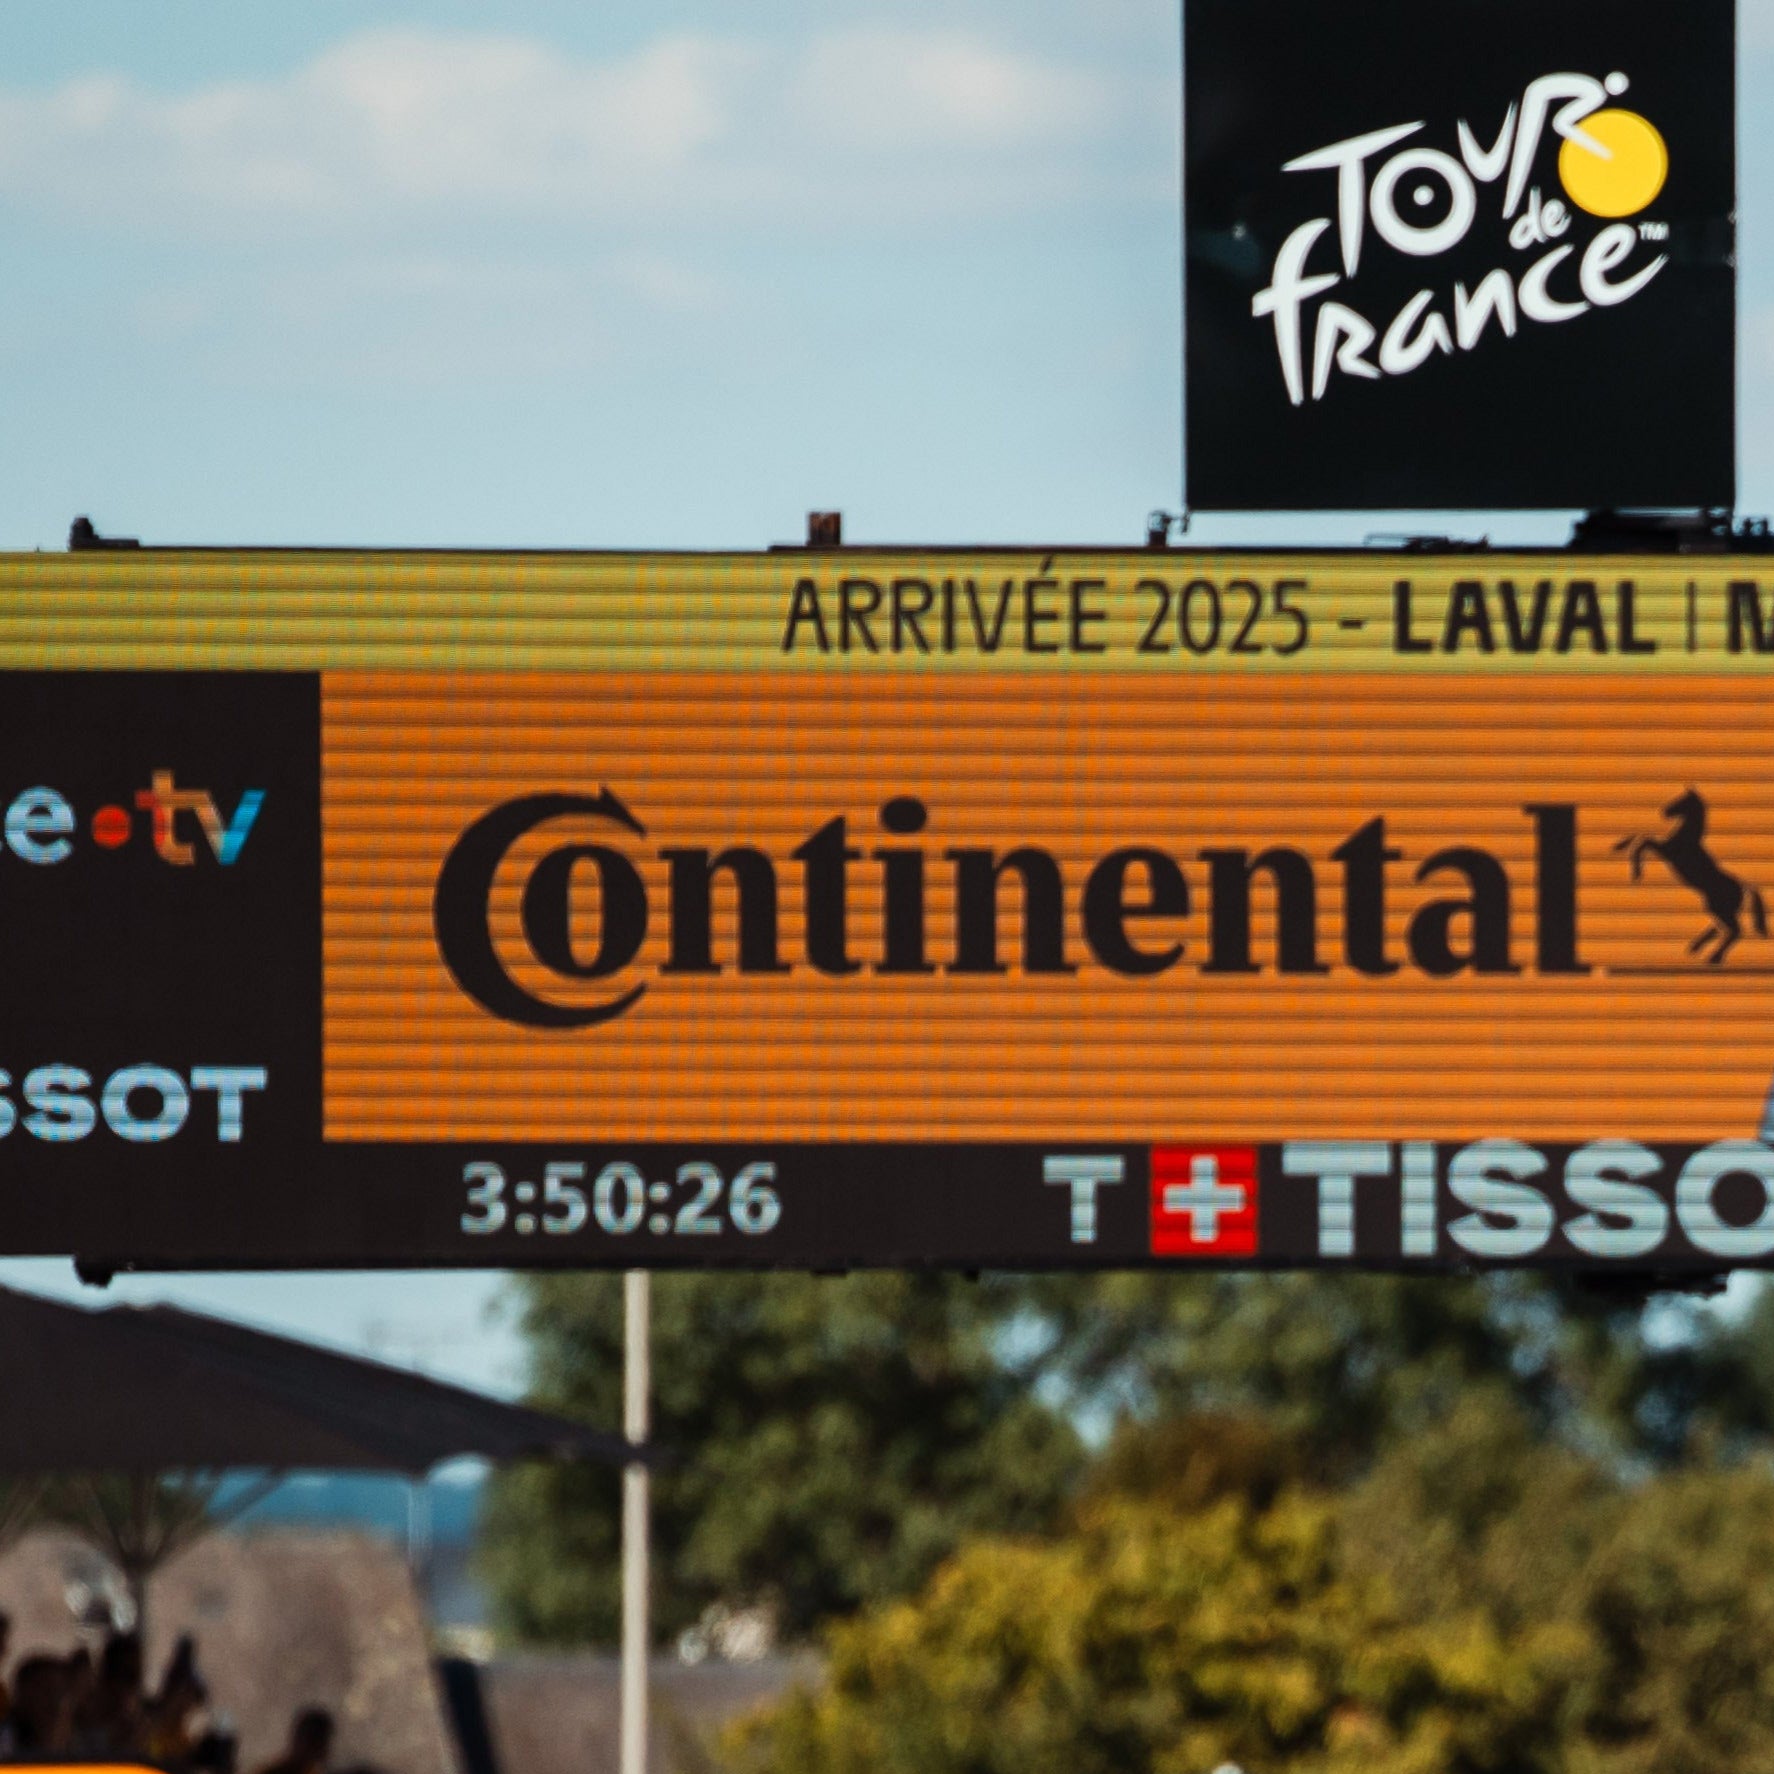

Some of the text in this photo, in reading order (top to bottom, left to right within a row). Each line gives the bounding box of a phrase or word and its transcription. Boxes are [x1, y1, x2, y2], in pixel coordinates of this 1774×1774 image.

[1508, 186, 1572, 250] de
[782, 557, 1107, 655] ARRIVÉE
[1133, 579, 1310, 656] 2025
[1392, 580, 1657, 655] LAVAL
[433, 785, 1594, 1031] Continental
[460, 1161, 782, 1236] 3:50:26
